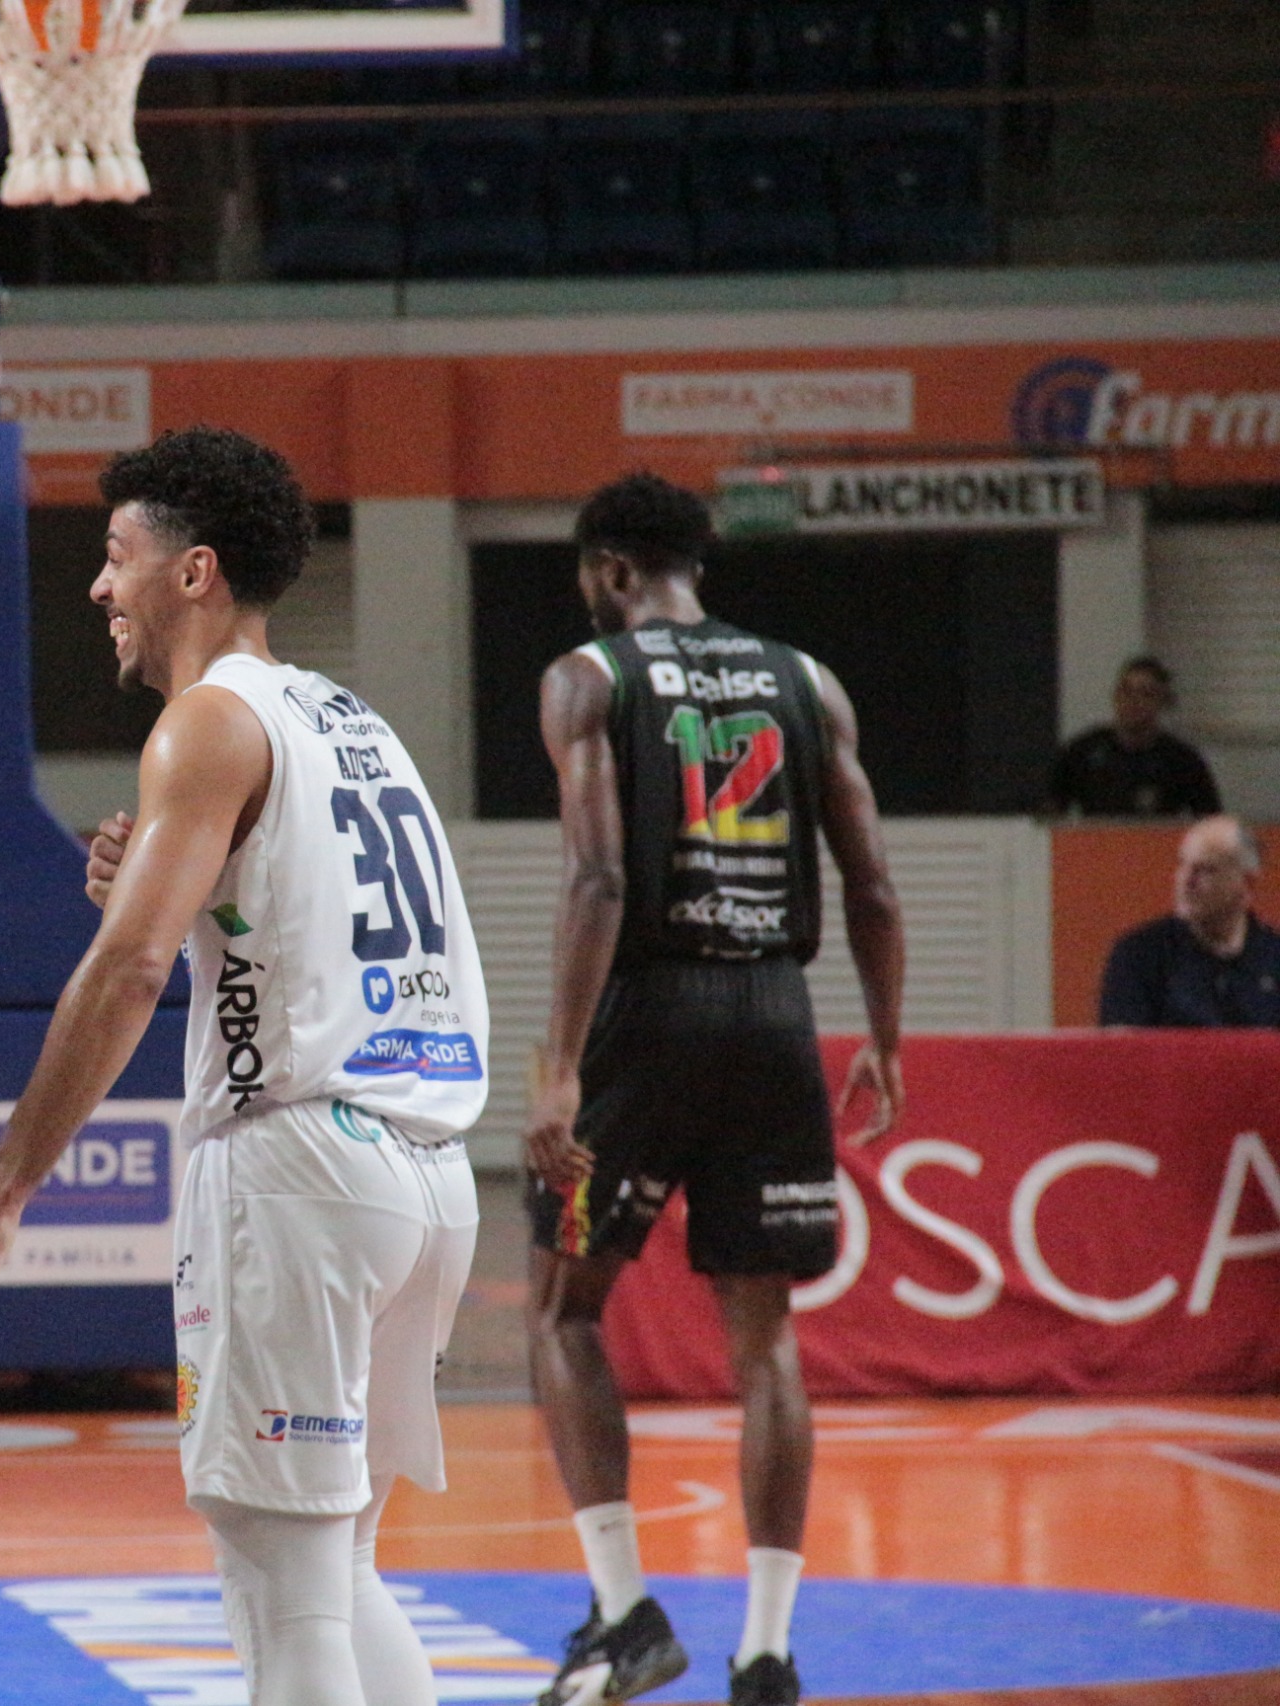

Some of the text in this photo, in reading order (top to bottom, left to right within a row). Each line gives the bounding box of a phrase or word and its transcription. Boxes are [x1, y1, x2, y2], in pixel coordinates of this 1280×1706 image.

[801, 472, 1095, 518] LANCHONETE
[664, 705, 790, 844] 12
[331, 786, 445, 962] 30
[358, 1037, 418, 1060] ARMA
